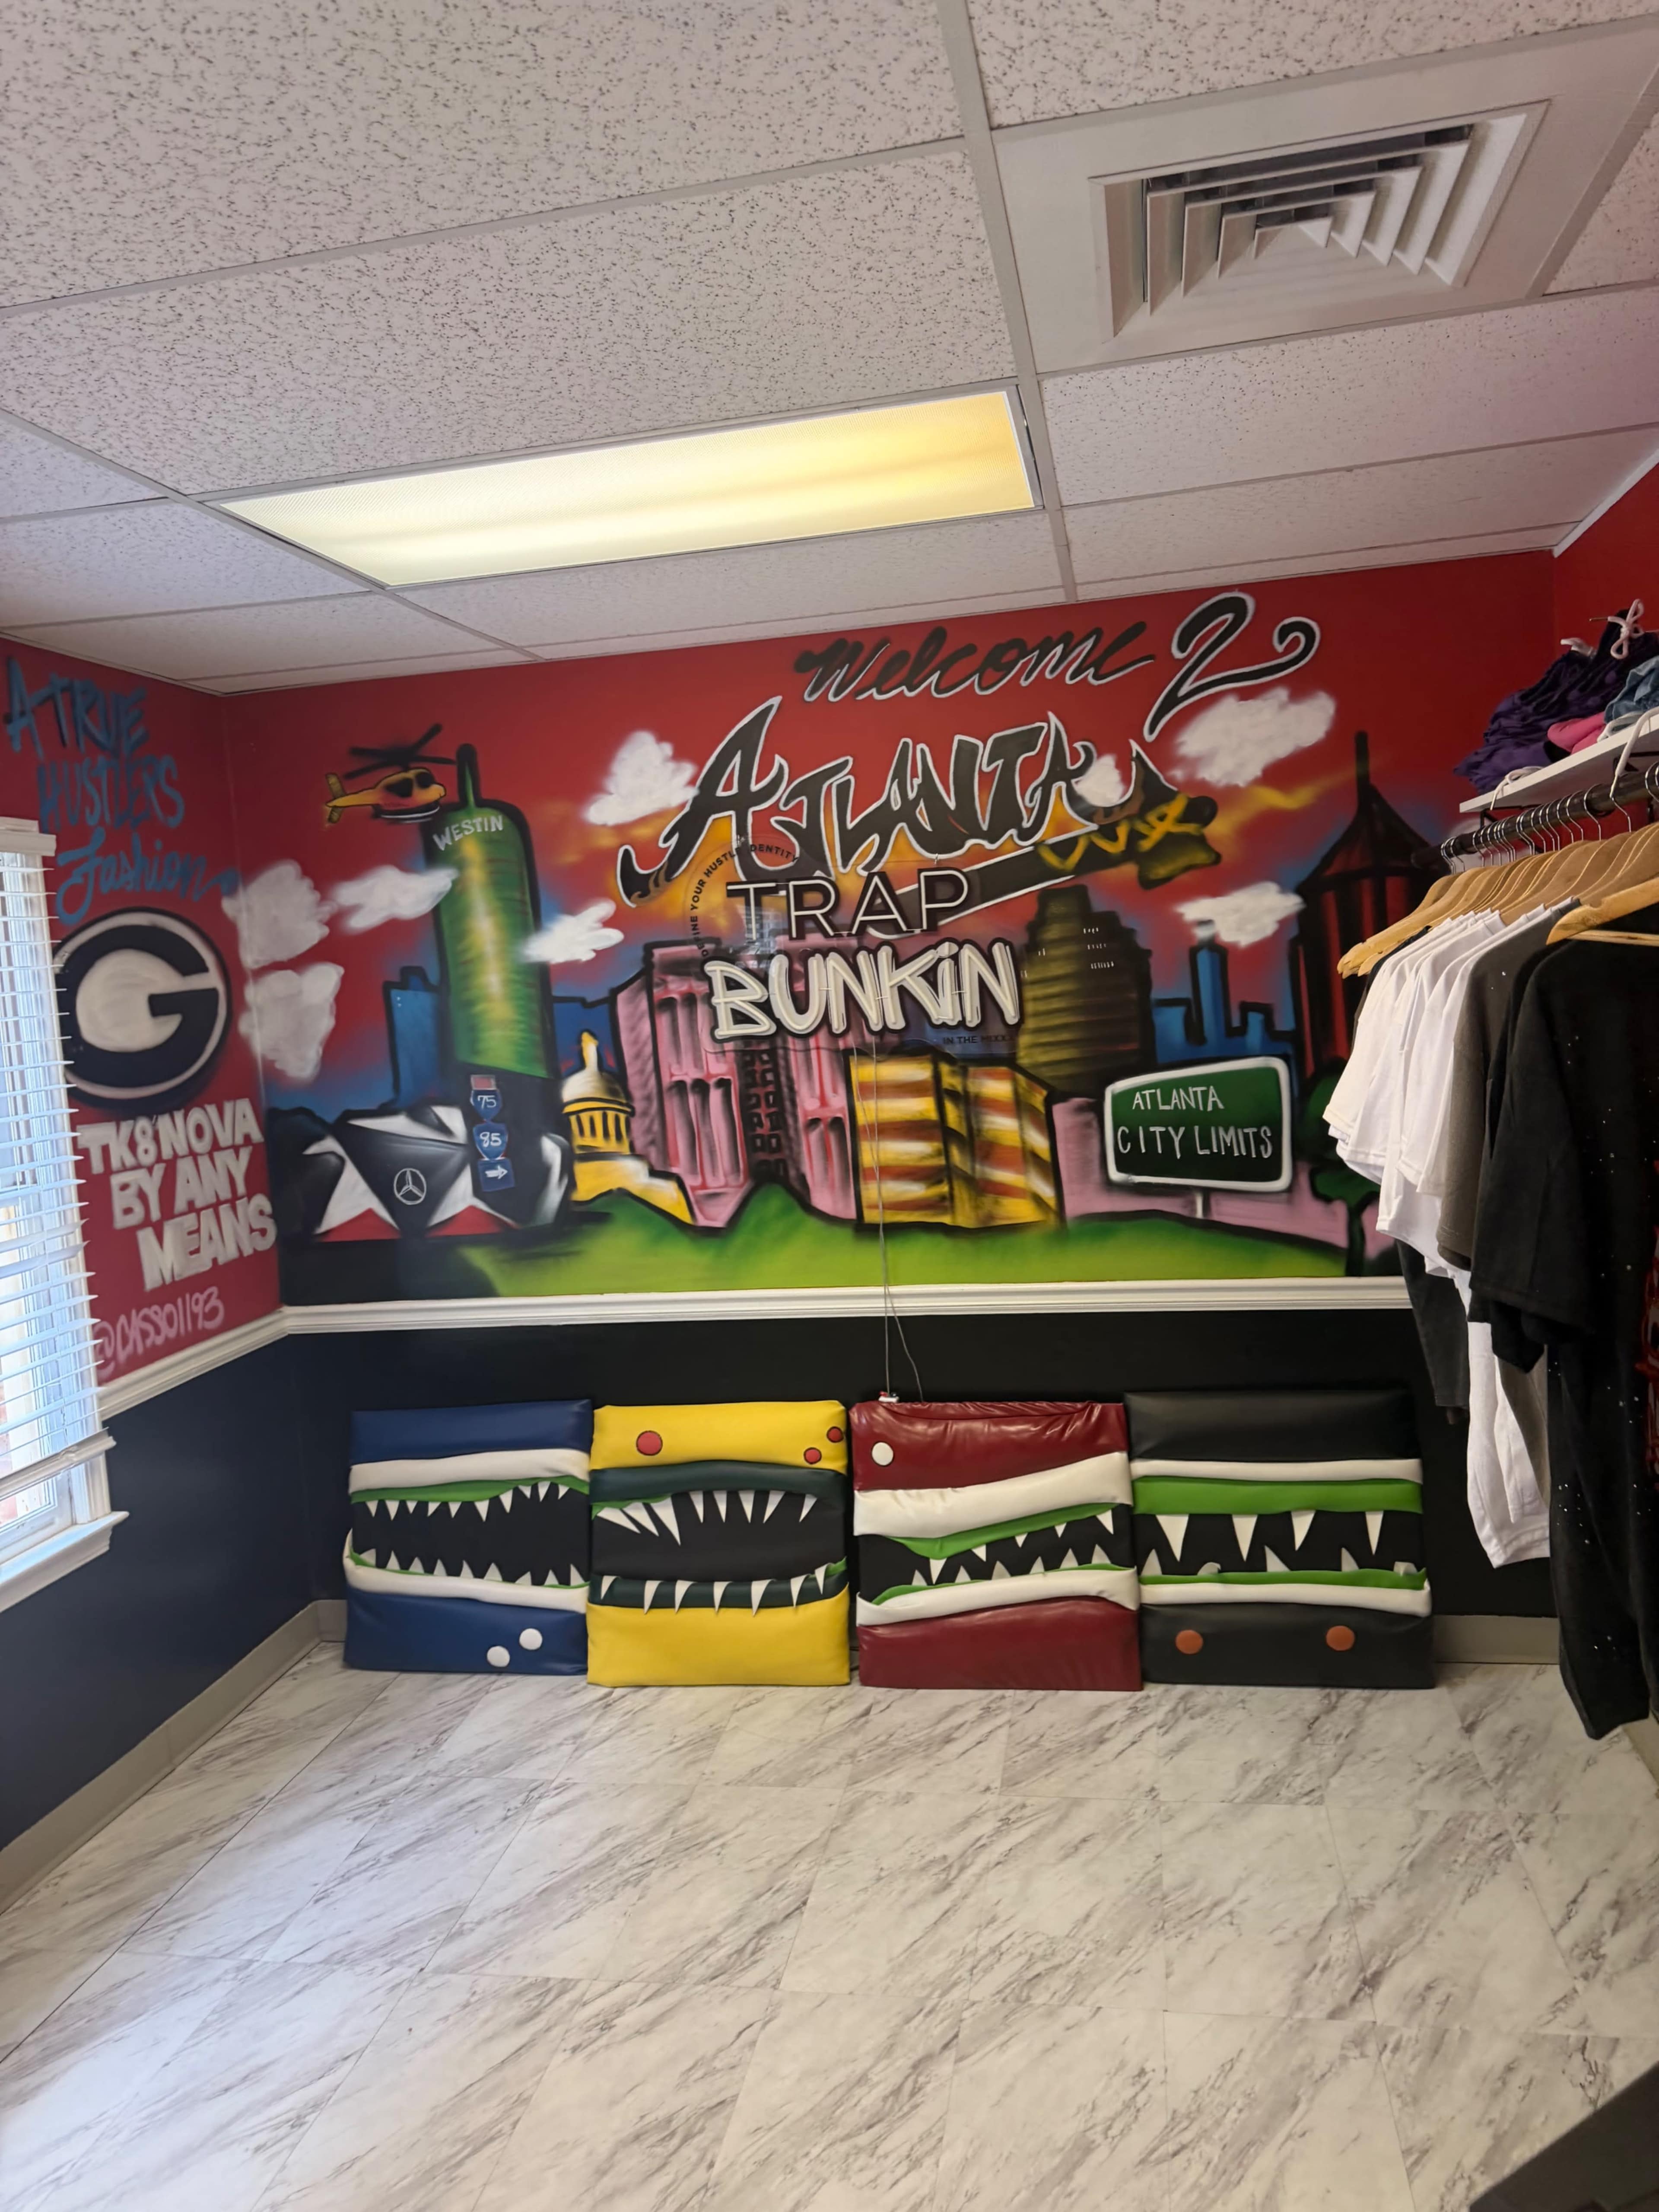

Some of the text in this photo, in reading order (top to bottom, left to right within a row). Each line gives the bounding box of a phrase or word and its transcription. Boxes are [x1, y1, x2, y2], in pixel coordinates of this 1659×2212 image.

[794, 591, 1320, 742] Welcome 2
[37, 754, 185, 833] HUSTLERS
[617, 695, 1100, 907] ATLANTA
[432, 815, 504, 851] WESTIN
[690, 879, 706, 910] YOUR
[750, 843, 799, 863] DENTITY
[726, 867, 970, 940] TRAP
[477, 1095, 496, 1110] 75
[1132, 1085, 1224, 1111] ATLANTA
[480, 1131, 502, 1148] 85
[1117, 1125, 1272, 1159] CITY LIMITS
[110, 1146, 253, 1230] BY ANY
[137, 1194, 278, 1292] MEANS
